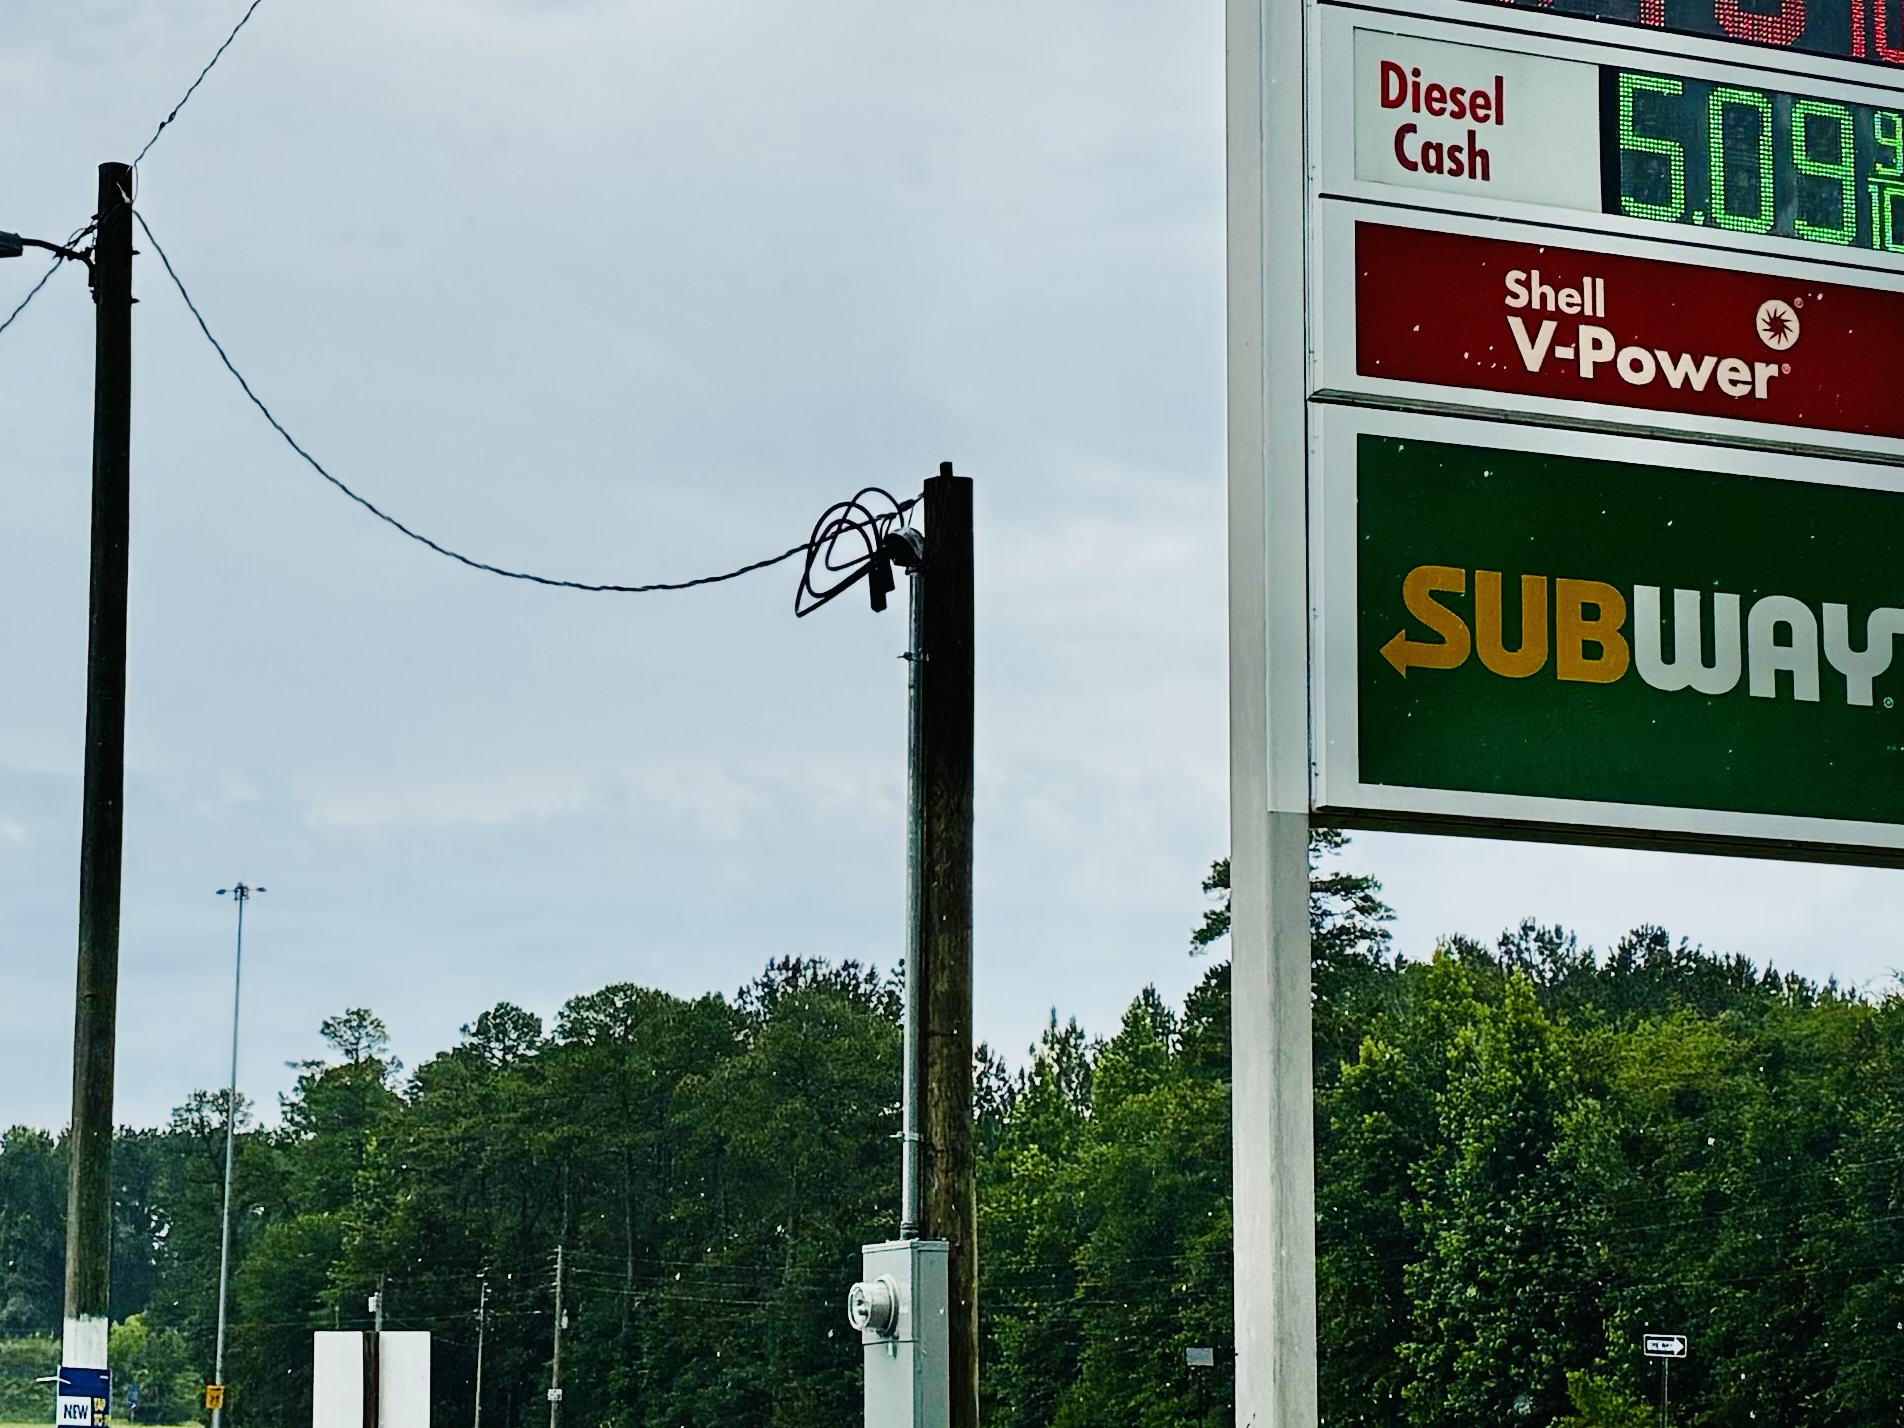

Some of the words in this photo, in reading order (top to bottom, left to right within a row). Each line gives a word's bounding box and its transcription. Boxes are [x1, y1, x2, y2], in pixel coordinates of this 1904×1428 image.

[1379, 60, 1506, 126] Diesel
[1393, 122, 1492, 182] Cash
[1618, 71, 1856, 247] 5.09
[1504, 269, 1606, 319] Shell
[1506, 315, 1780, 400] V-Power
[63, 1403, 89, 1420] NEW
